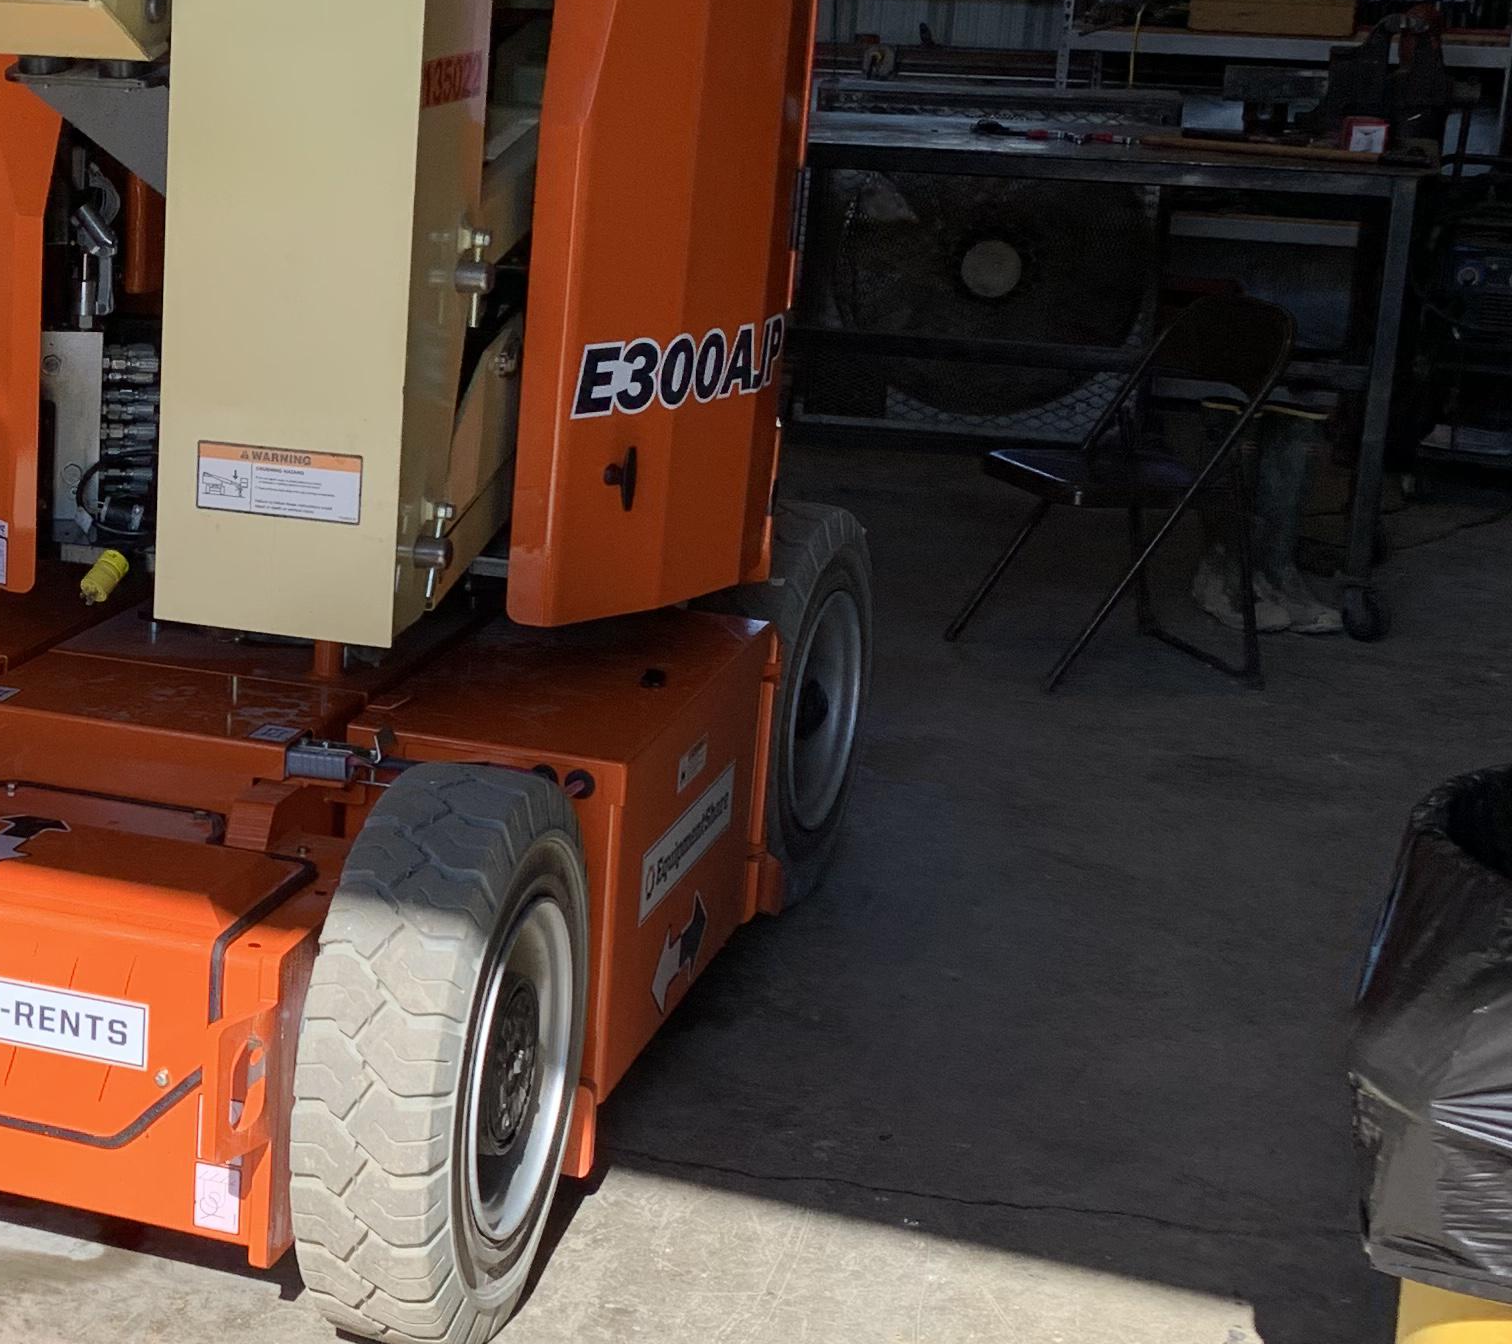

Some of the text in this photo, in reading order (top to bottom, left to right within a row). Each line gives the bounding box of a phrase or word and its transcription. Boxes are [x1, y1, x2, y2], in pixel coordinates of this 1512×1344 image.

[569, 313, 785, 420] E300AJP
[252, 450, 312, 465] WARNING
[656, 792, 730, 884] EquipmentShare
